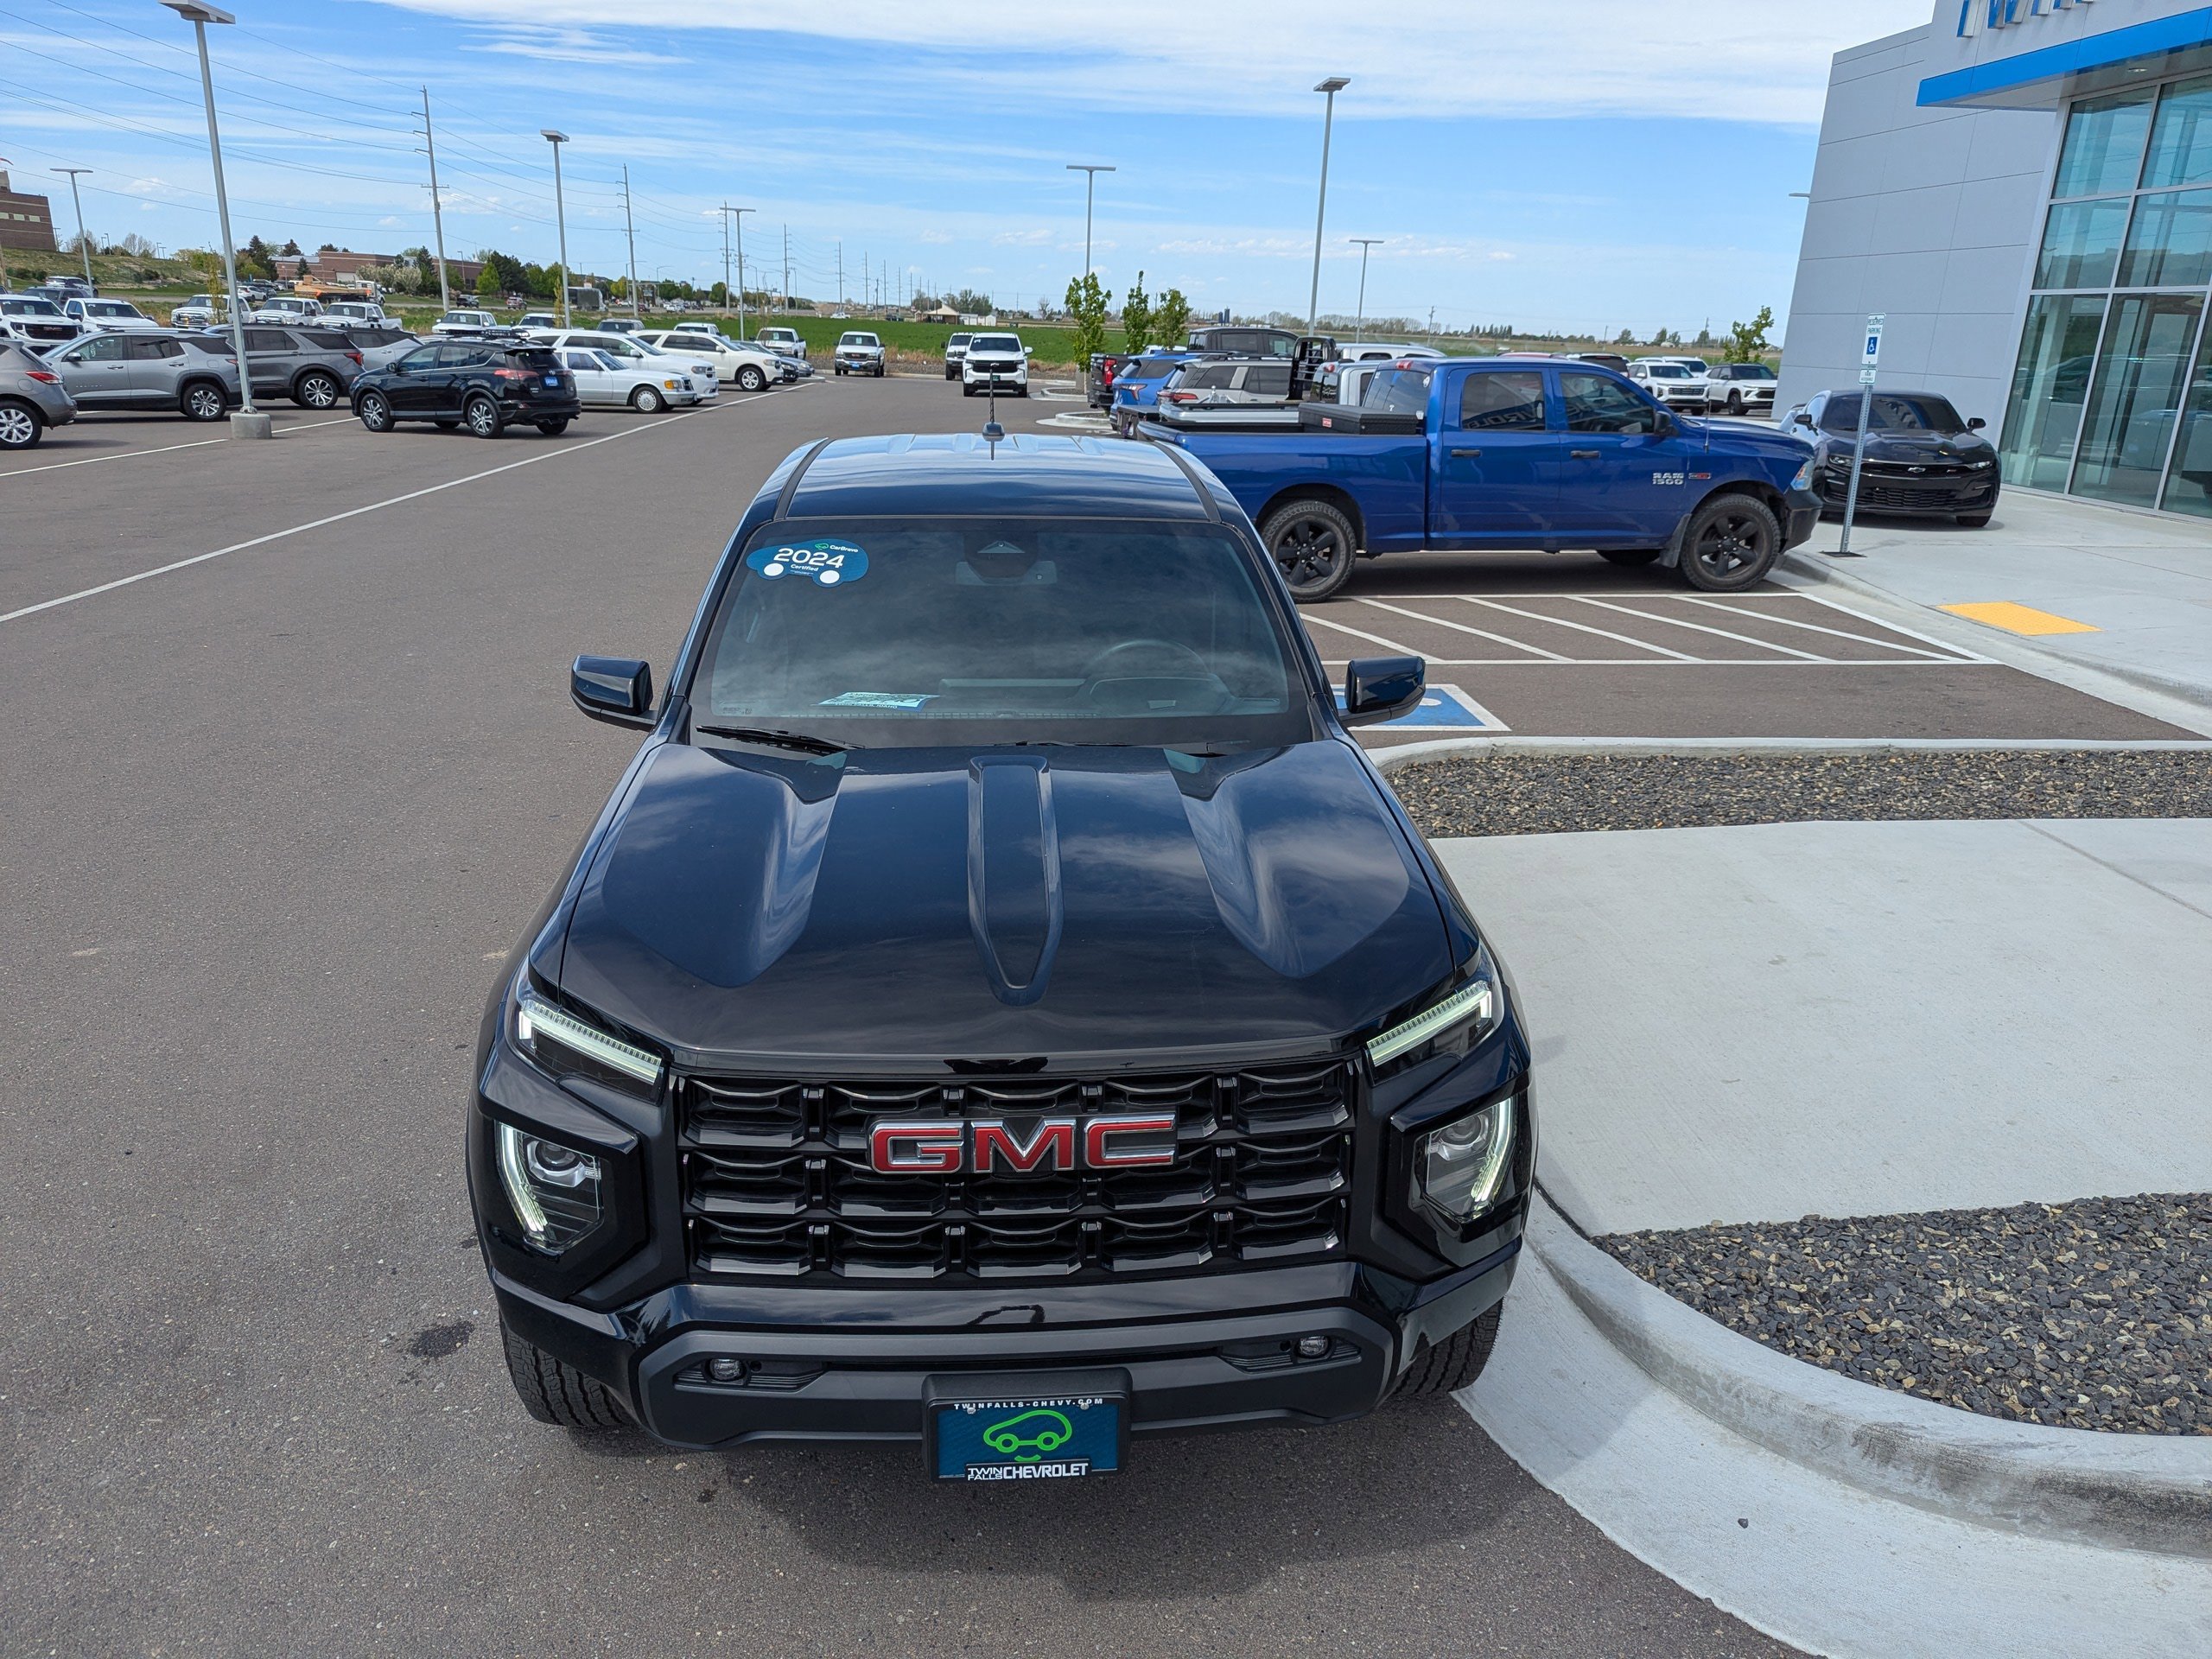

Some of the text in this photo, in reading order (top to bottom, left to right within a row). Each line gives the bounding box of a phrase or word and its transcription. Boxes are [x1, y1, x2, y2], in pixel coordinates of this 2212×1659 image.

[830, 544, 859, 553] CarBravo
[773, 548, 845, 569] 2024
[790, 563, 819, 572] Certified
[870, 1114, 1175, 1173] GMC
[953, 1398, 1103, 1410] TWINFALLS-CHEVY.COM
[1003, 1463, 1089, 1479] CHEVROLET
